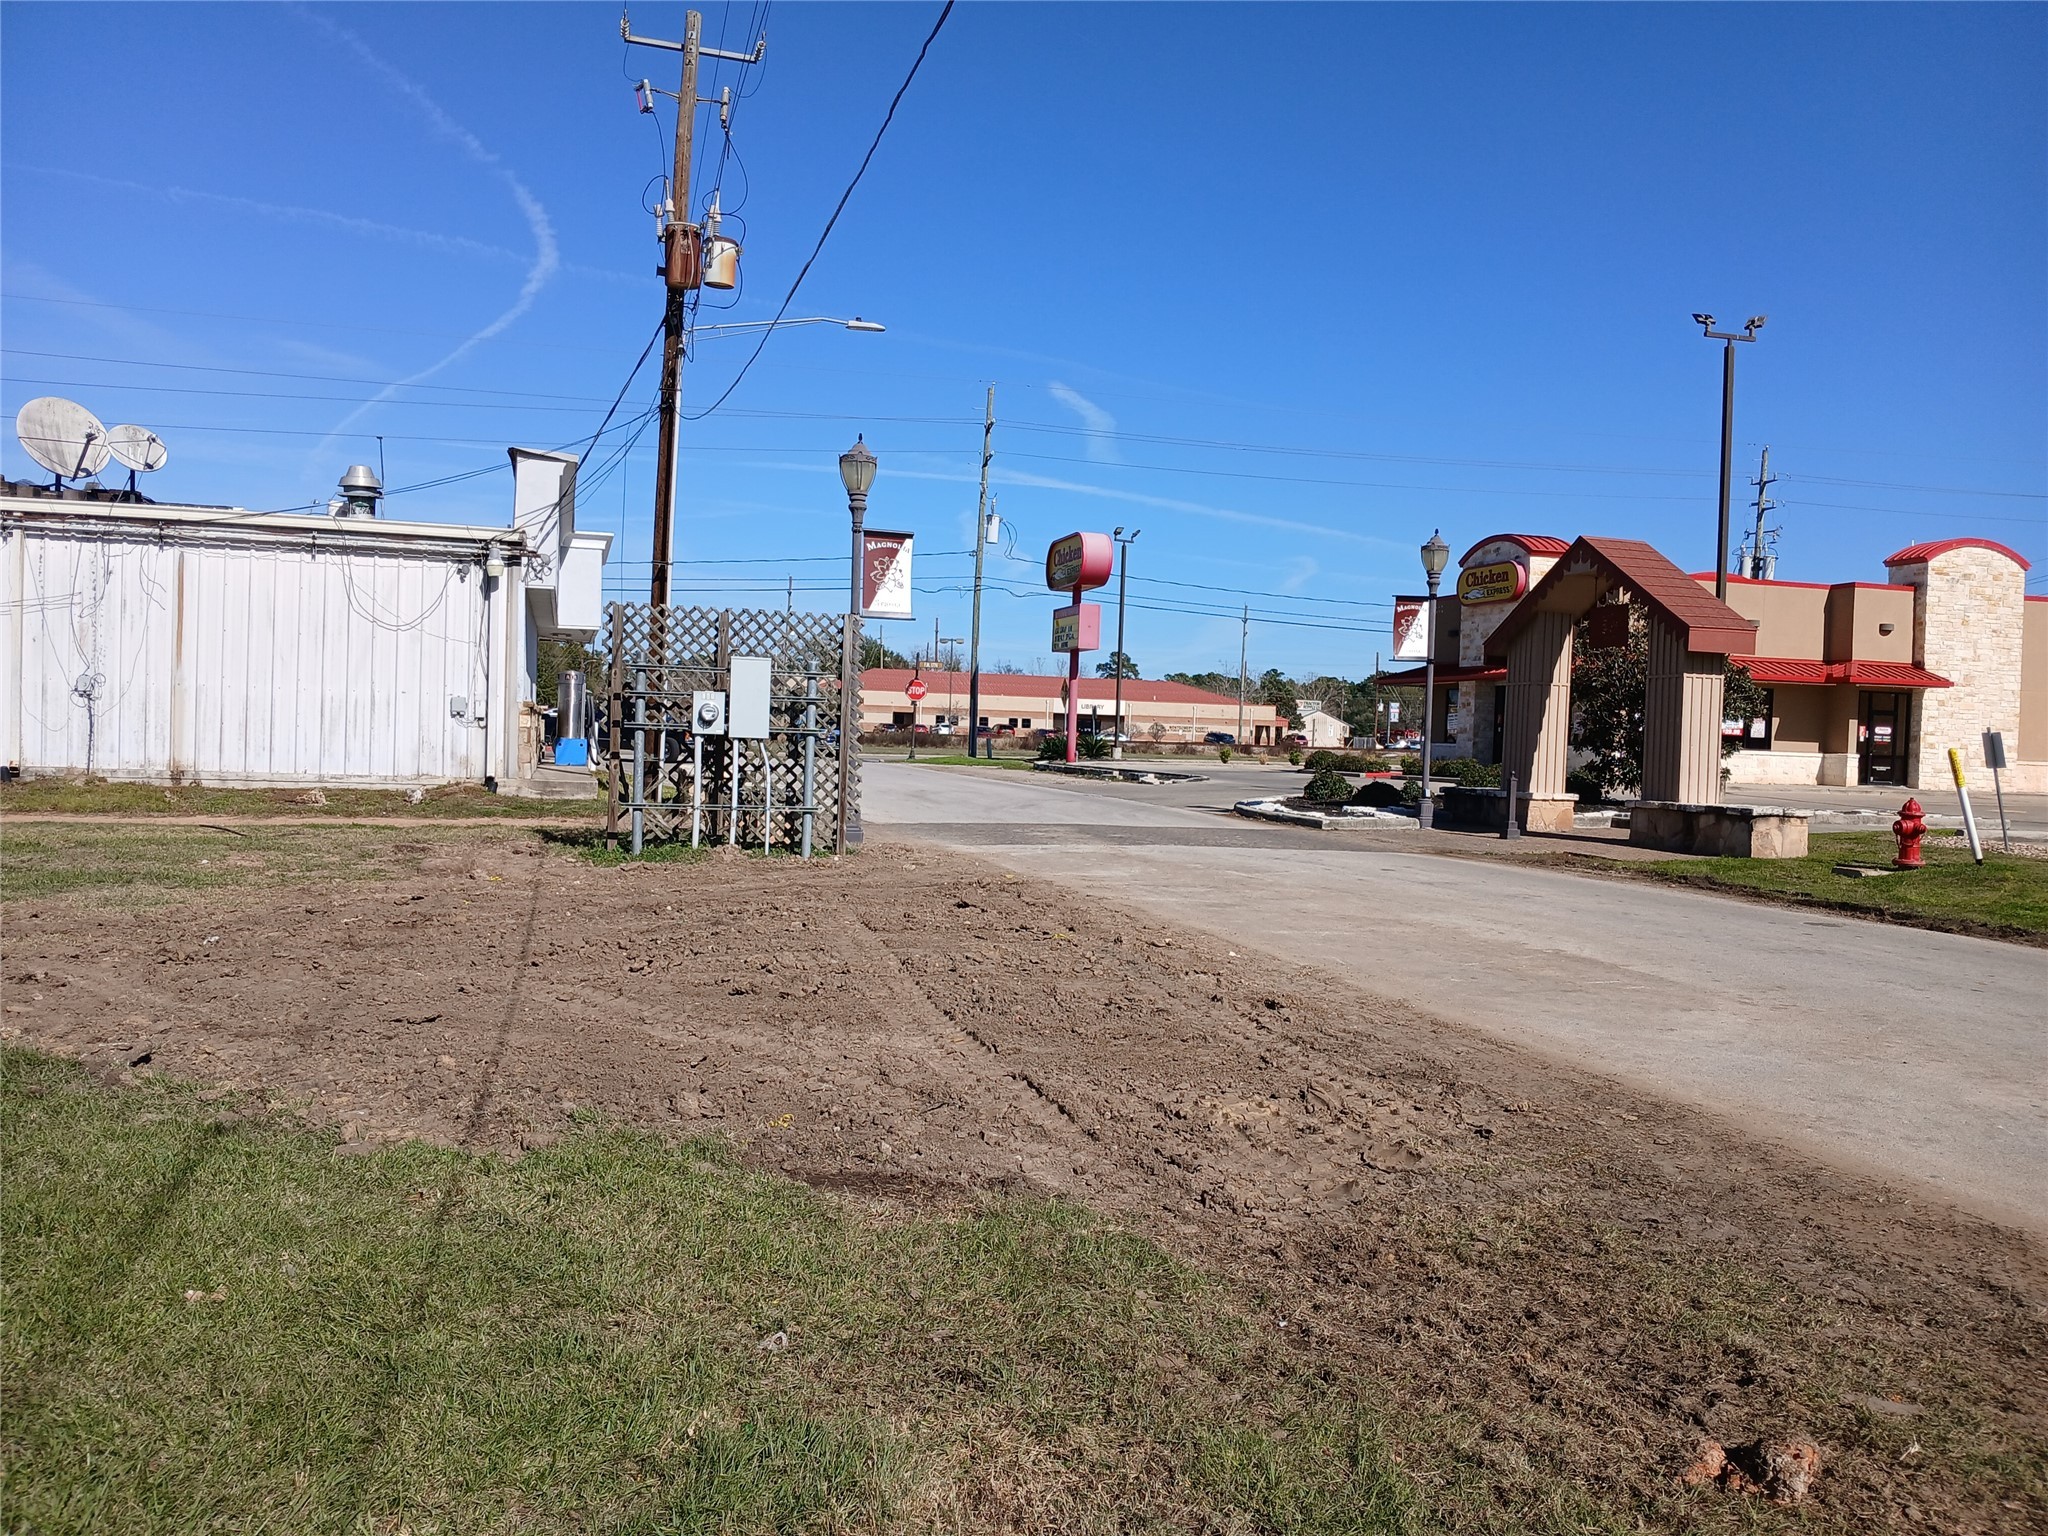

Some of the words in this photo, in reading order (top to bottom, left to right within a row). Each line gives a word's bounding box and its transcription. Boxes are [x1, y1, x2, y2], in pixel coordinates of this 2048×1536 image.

[1054, 546, 1082, 567] Chicken
[1465, 569, 1510, 588] Chicken
[1486, 586, 1510, 596] EXPRESS
[908, 686, 925, 695] STOP
